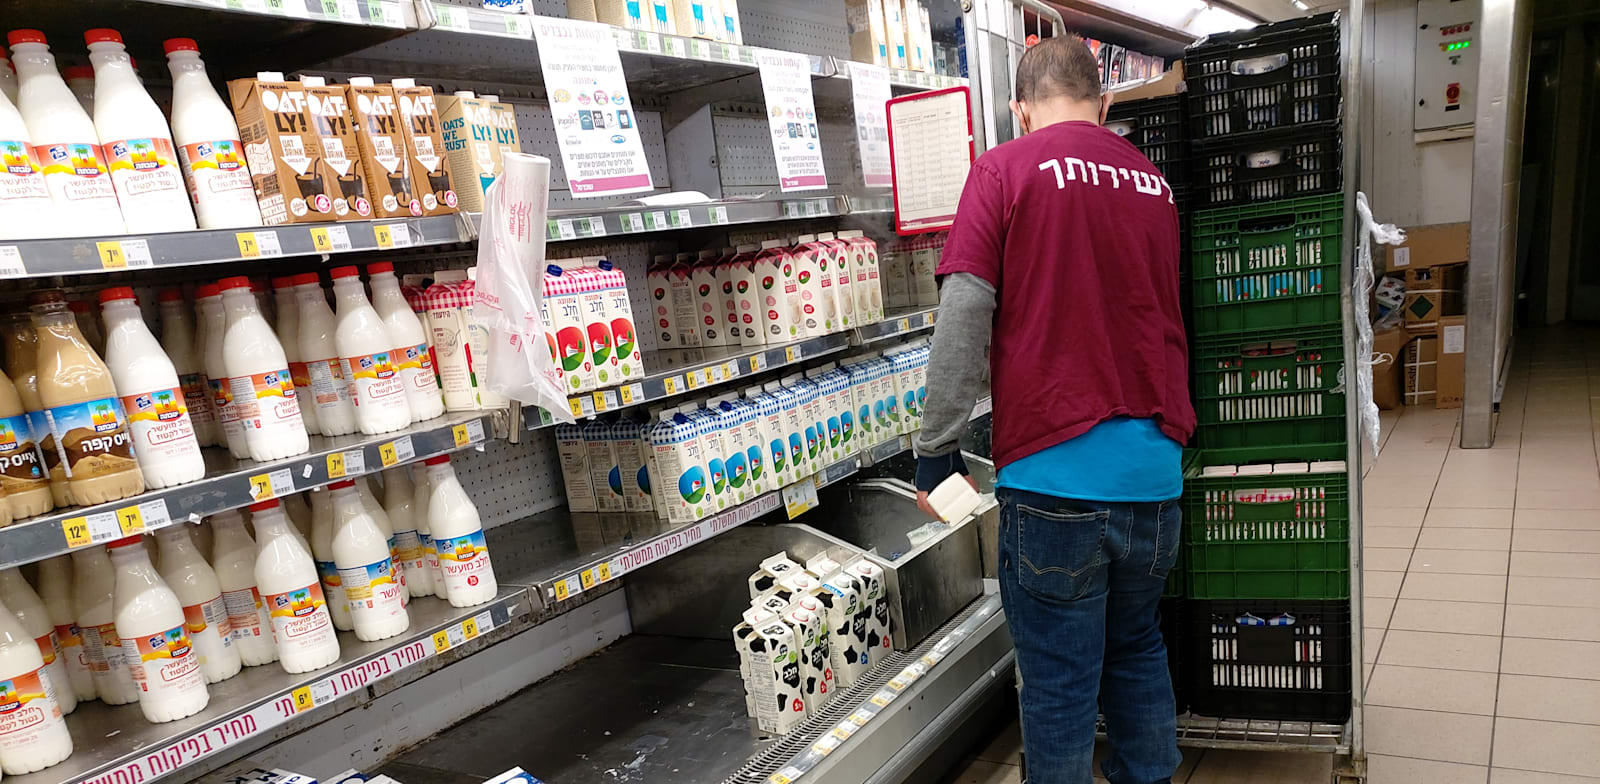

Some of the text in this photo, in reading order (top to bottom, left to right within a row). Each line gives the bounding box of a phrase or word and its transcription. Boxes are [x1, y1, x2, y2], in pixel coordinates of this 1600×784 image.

[540, 24, 573, 38] נכבדים
[274, 112, 308, 133] LY!
[317, 116, 348, 136] LY!
[368, 115, 396, 134] LY!
[413, 115, 436, 135] LY!
[443, 118, 465, 132] OATS
[443, 130, 458, 142] WE
[472, 124, 492, 141] LY!
[496, 127, 517, 145] LY!
[285, 147, 304, 157] DRINK
[376, 147, 394, 156] DRINK
[418, 147, 433, 156] DRINK
[445, 138, 467, 152] RUST
[326, 149, 345, 158] DRINK
[589, 301, 605, 313] חלב
[614, 297, 628, 309] חלב
[562, 305, 579, 317] חלב
[160, 411, 179, 420] יטבתה
[97, 423, 118, 432] יטבתה
[152, 422, 176, 433] מועשר
[156, 430, 178, 441] לקטוז
[81, 436, 113, 453] קפה
[11, 451, 38, 467] אייס
[761, 493, 777, 509] מחיר
[737, 499, 760, 523] בפיקוח
[709, 511, 737, 533] ממשלתי
[619, 526, 703, 571] מחיר בפיקוח ממשלתי
[445, 556, 489, 576] חלב מועשר
[877, 602, 887, 615] חלב
[288, 611, 325, 628] חלב מועשר
[854, 618, 865, 631] חלב
[292, 623, 313, 634] לקטוז
[164, 656, 188, 670] מועשר
[812, 650, 822, 663] חלב
[169, 665, 189, 677] לקטוז
[340, 641, 426, 692] מחיר בפיקוח
[784, 666, 798, 679] חלב
[0, 706, 35, 725] חלב מוע
[0, 714, 38, 731] נטול לקט
[213, 713, 258, 745] מחיר
[147, 732, 213, 770] בפיקוח
